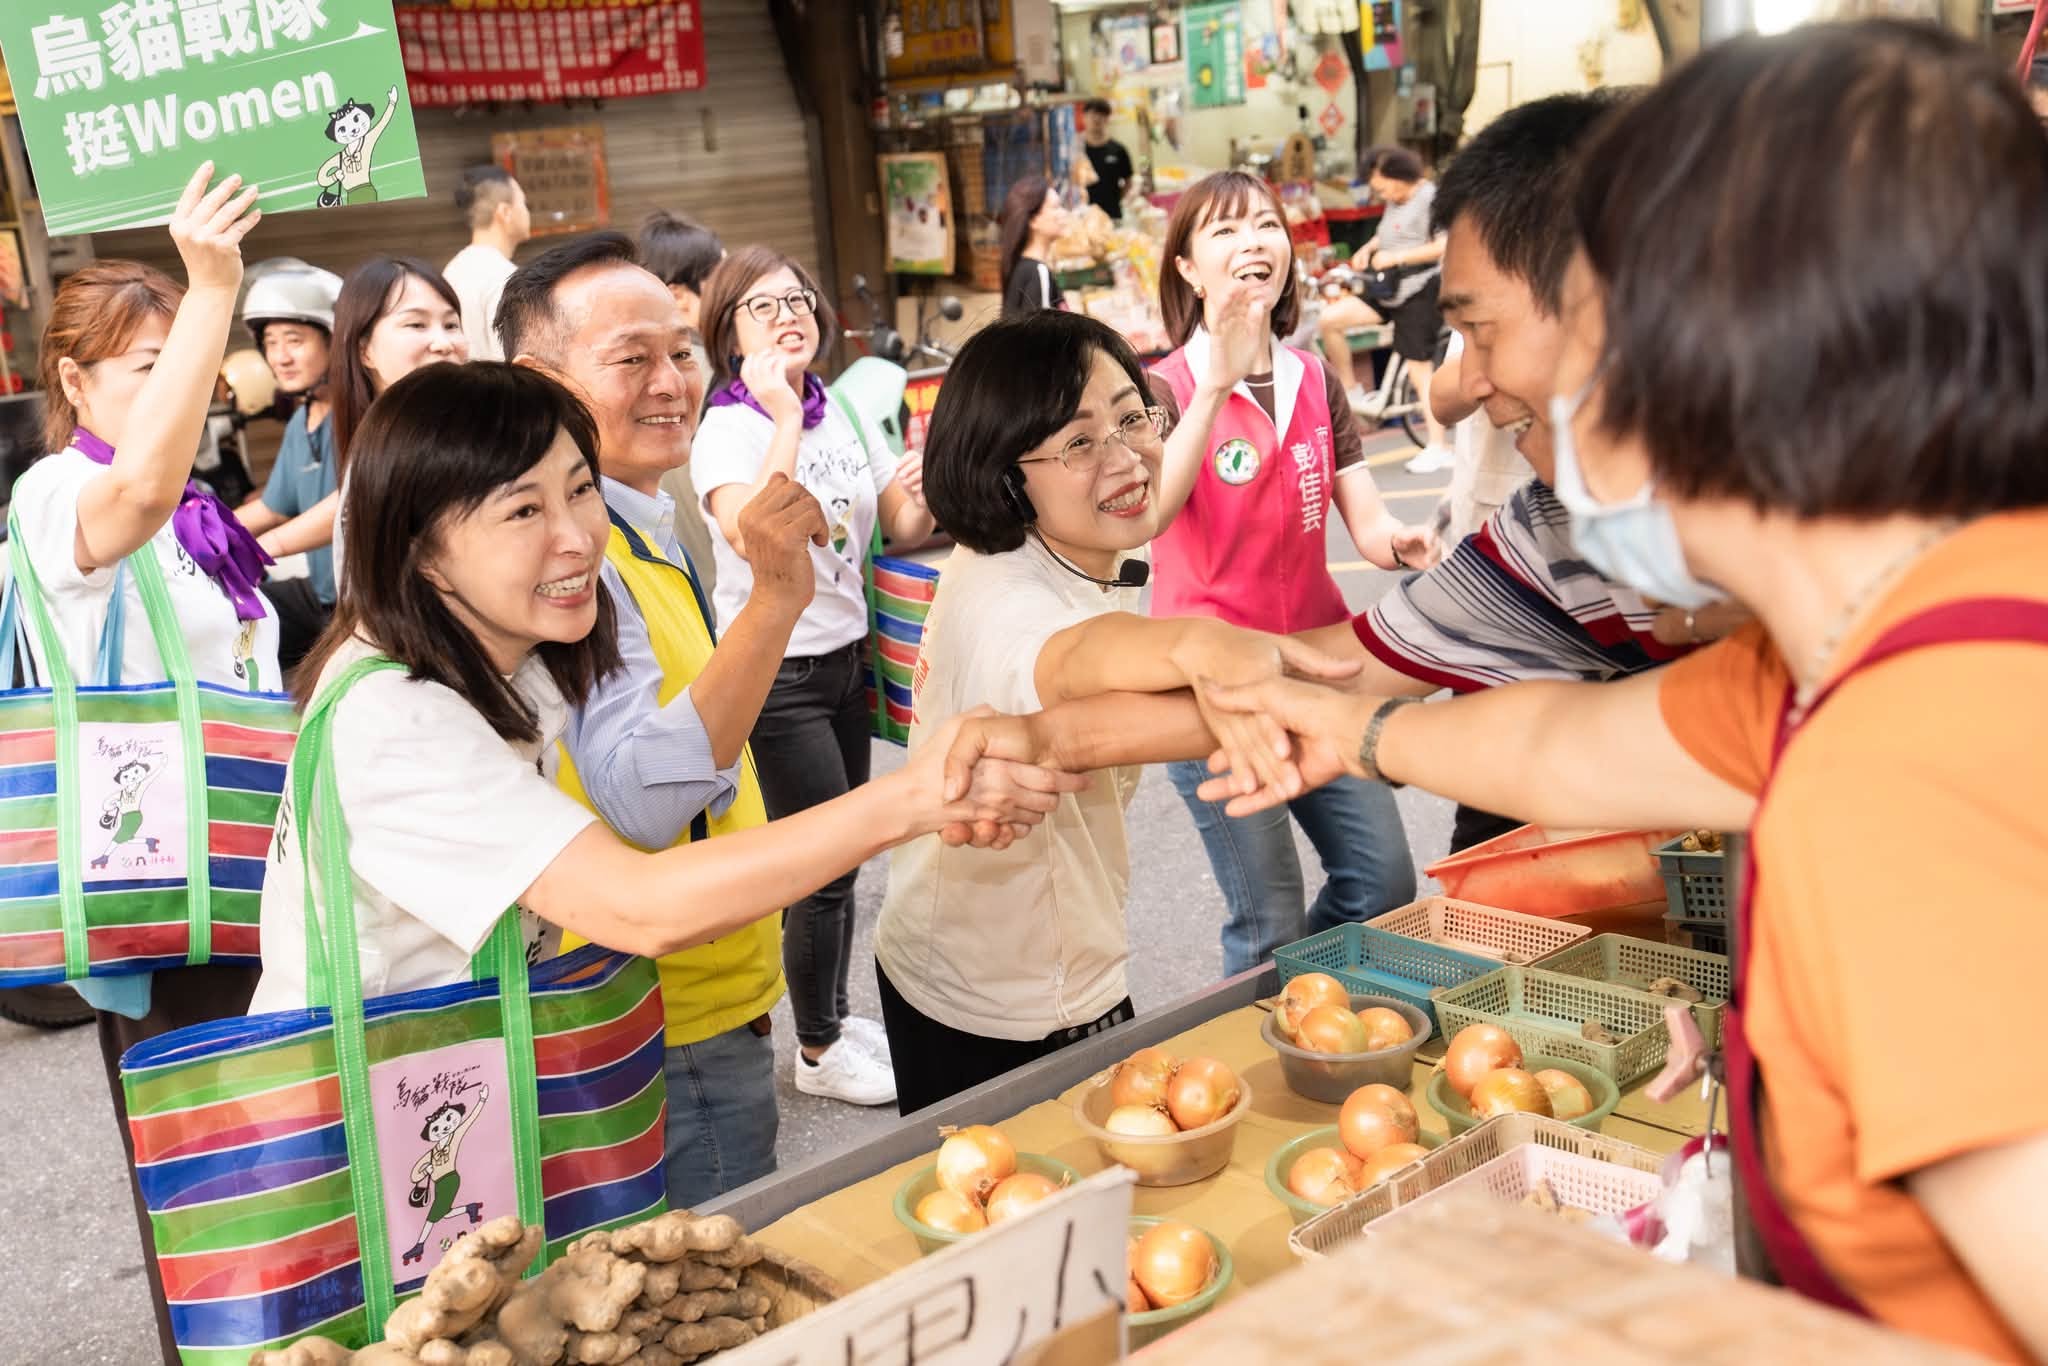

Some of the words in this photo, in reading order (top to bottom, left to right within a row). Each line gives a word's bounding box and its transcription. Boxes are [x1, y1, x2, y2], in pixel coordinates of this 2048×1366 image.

[32, 0, 329, 100] 烏貓戰隊
[63, 70, 338, 177] 挺Women
[1290, 440, 1322, 533] 彭佳芸
